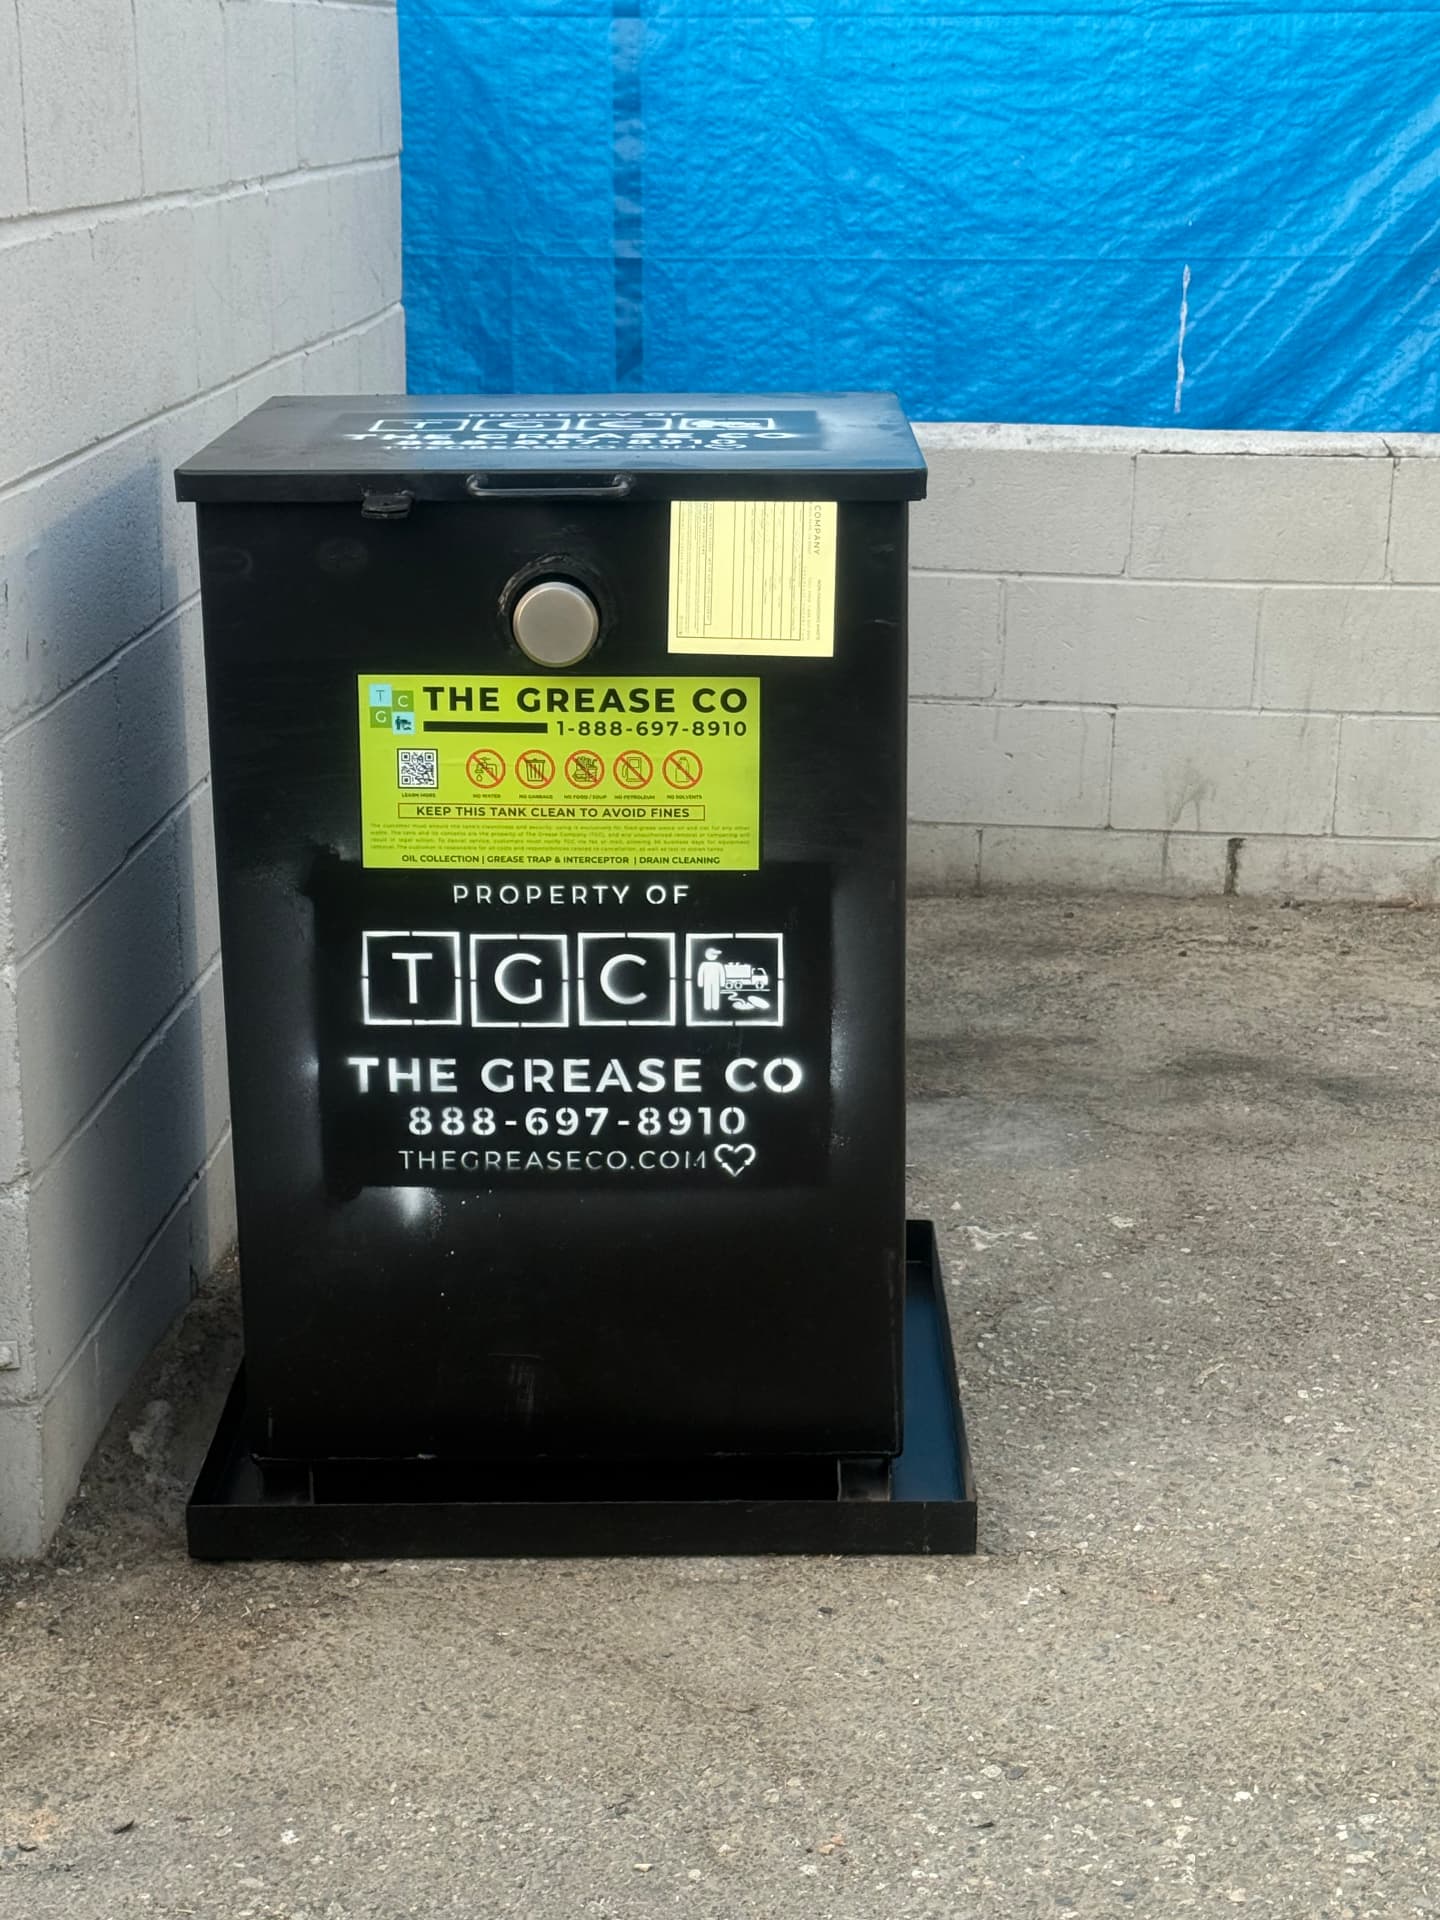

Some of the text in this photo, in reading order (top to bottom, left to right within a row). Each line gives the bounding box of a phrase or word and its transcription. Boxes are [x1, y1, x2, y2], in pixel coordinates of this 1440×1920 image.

[403, 420, 644, 429] T G C
[475, 432, 694, 440] GREASE
[813, 504, 822, 556] COMPANY
[422, 686, 748, 714] THE GREASE CO
[557, 720, 747, 736] 1-888-697-8910
[416, 806, 690, 818] KEEP THIS TANK CLEAN TO AVOID FINES
[401, 854, 418, 863] OIL
[420, 855, 479, 863] COLLECTION
[486, 855, 524, 863] GREASE
[563, 856, 629, 864] INTERCEPTOR
[453, 884, 690, 905] PROPERTY OF
[391, 952, 647, 1005] T G C
[347, 1056, 804, 1094] THE GREASE CO
[408, 1106, 746, 1136] 888-697-8910
[398, 1150, 706, 1170] THEGREASECO.COM
